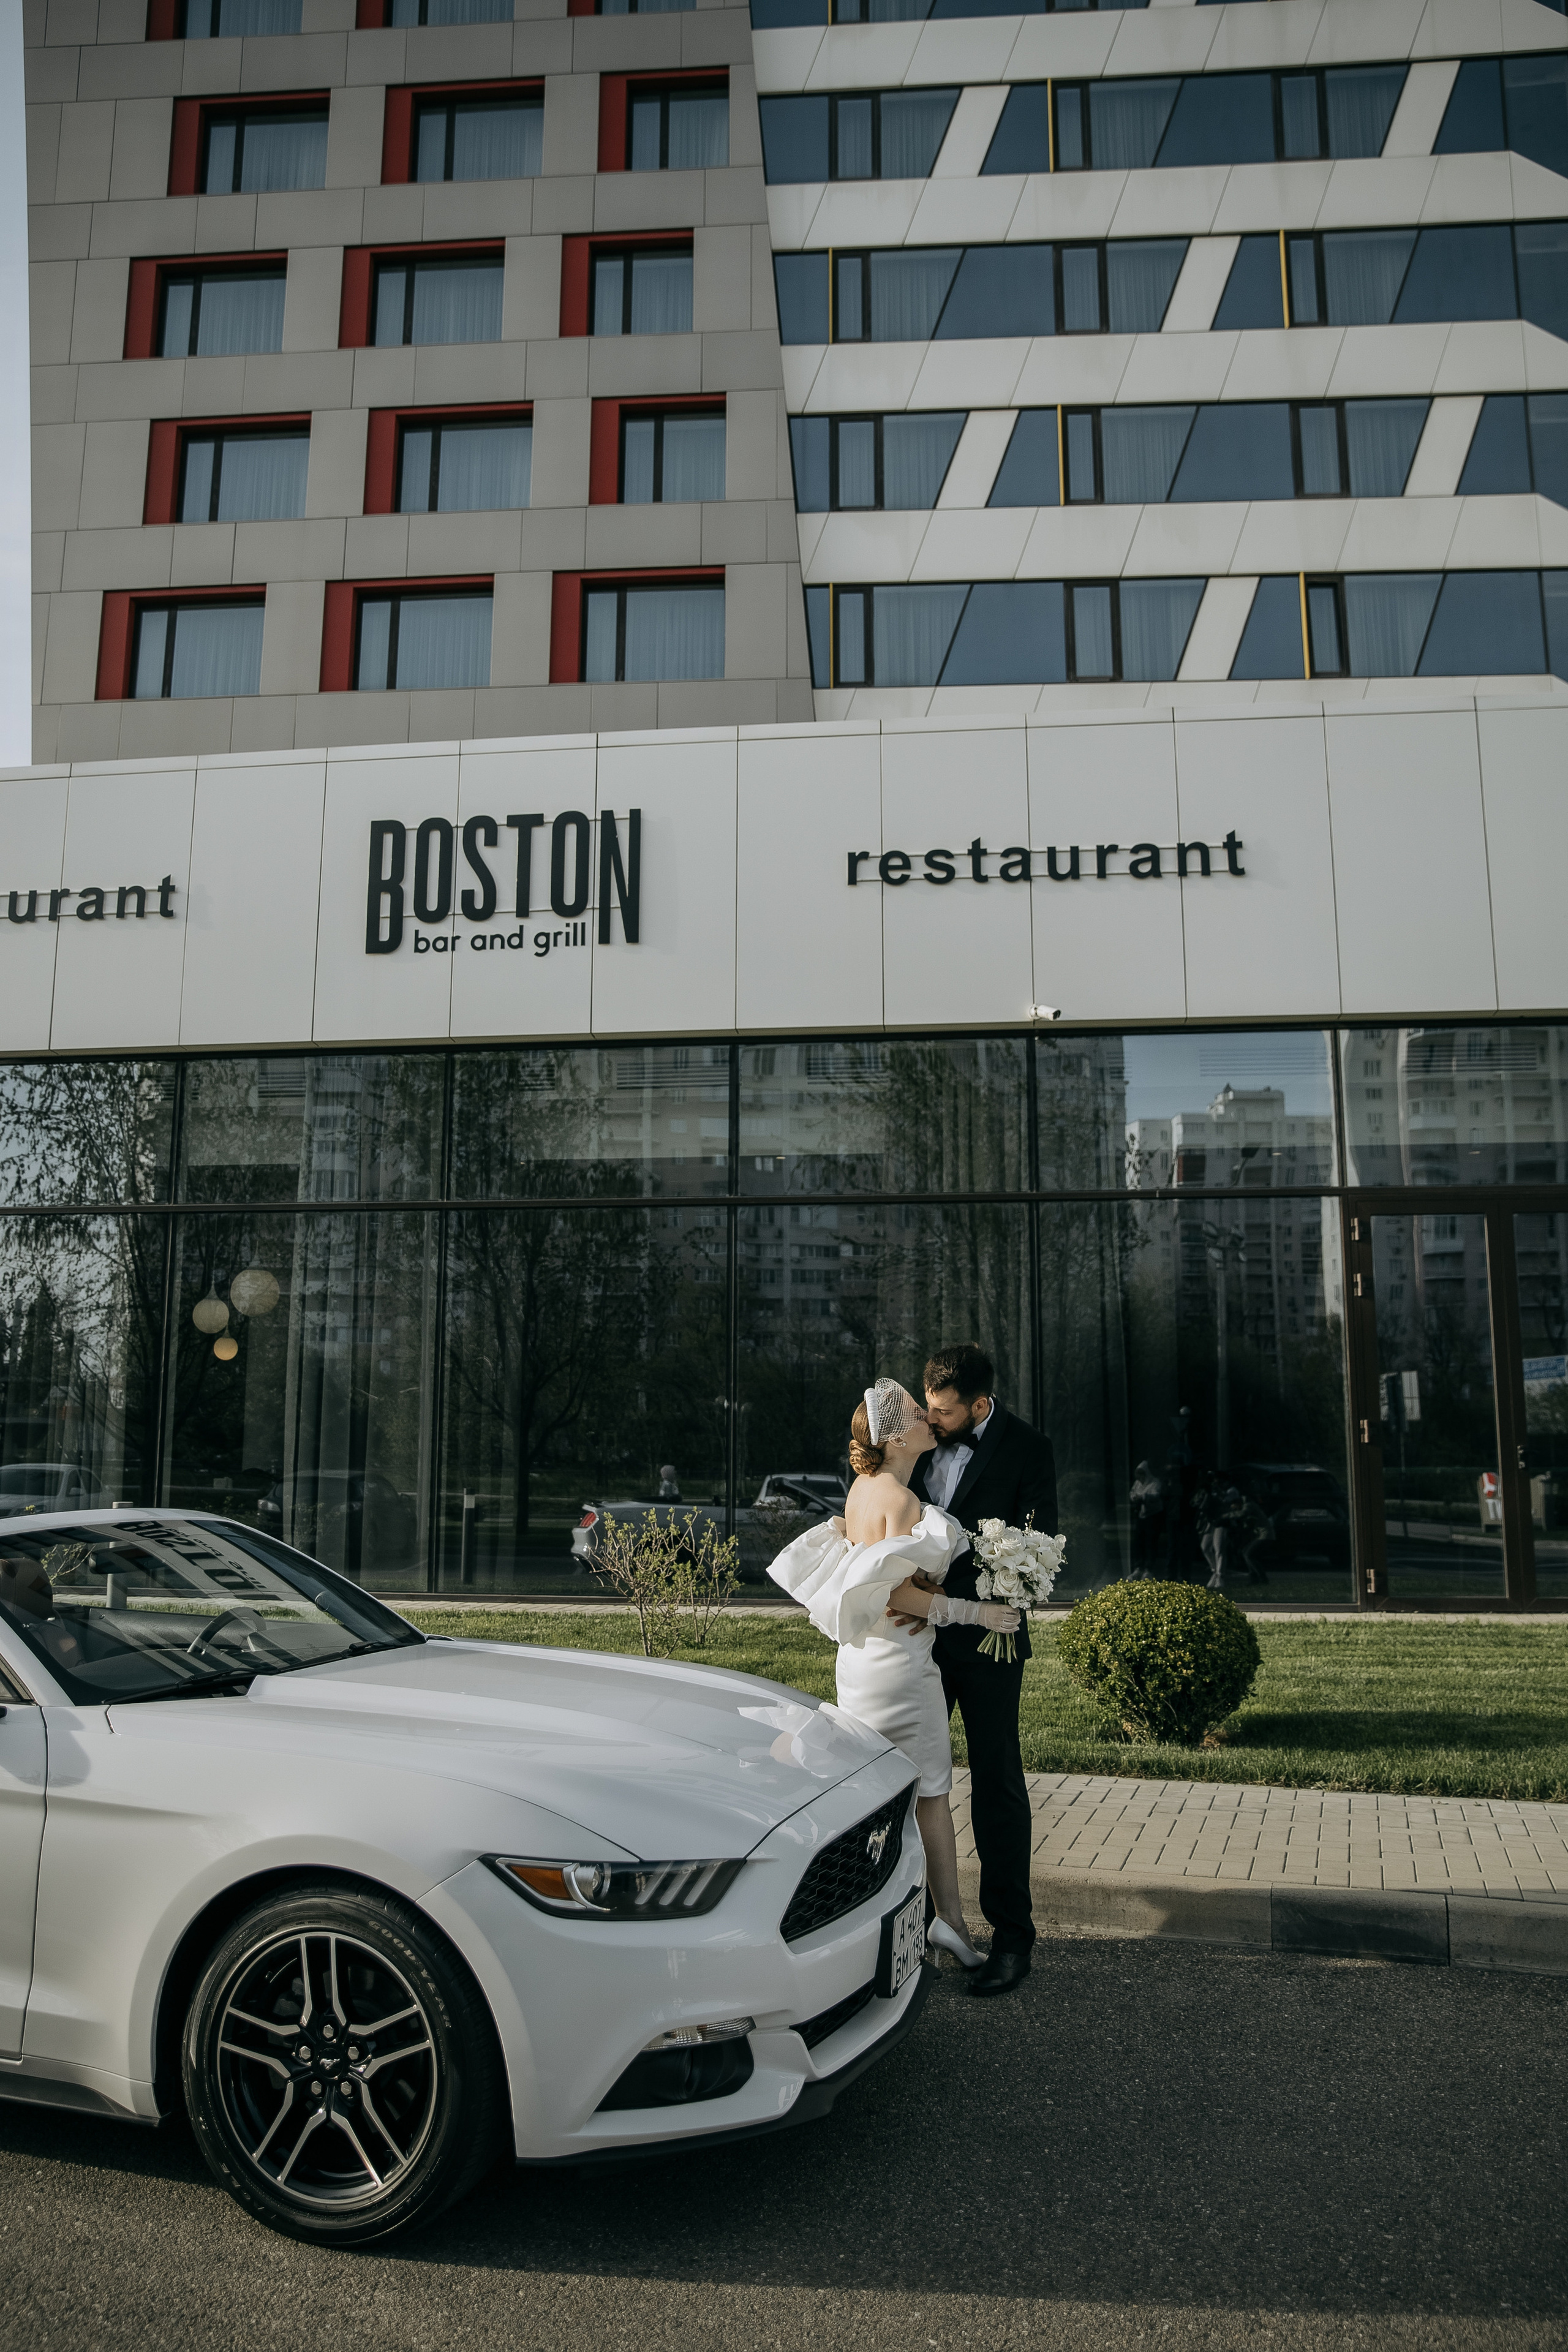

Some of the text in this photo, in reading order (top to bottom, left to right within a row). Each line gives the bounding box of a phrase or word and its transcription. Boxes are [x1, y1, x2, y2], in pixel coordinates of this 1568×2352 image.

[366, 808, 641, 954] BOSTON
[847, 830, 1245, 886] restaurant
[7, 875, 176, 924] urant
[413, 922, 586, 957] bar and grill
[899, 1899, 922, 1947] A 407
[911, 1929, 923, 1958] 193
[895, 1945, 909, 1985] BM
